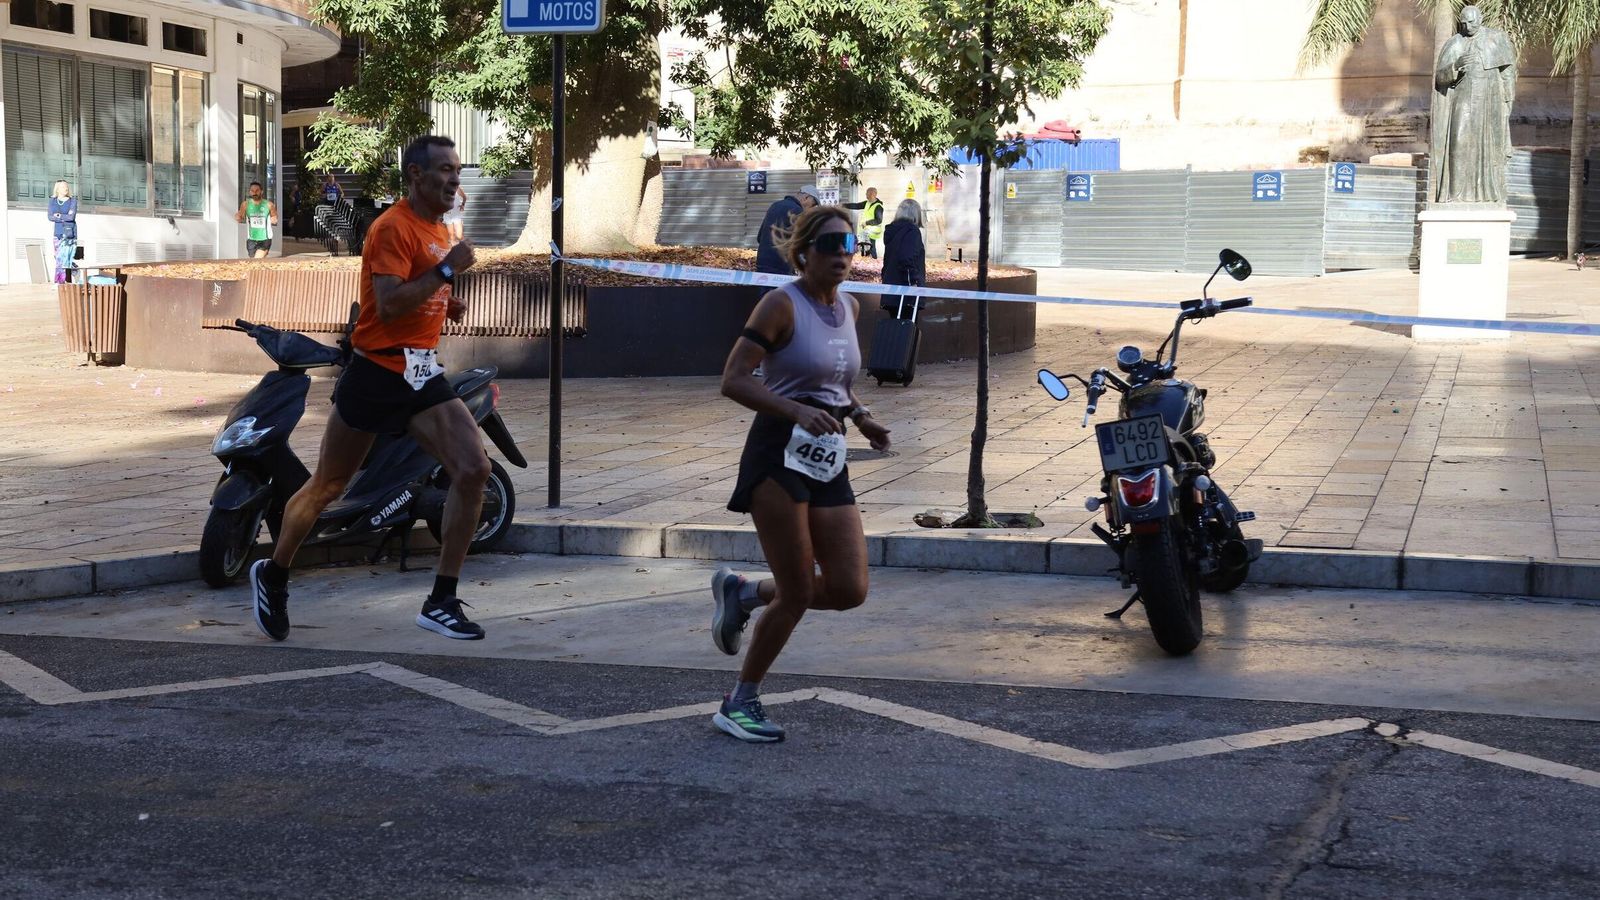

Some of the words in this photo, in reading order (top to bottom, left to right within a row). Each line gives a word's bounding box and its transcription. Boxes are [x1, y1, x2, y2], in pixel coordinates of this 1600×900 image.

[540, 1, 594, 20] MOTOS
[412, 364, 432, 378] 150
[1114, 421, 1161, 445] 6492
[795, 442, 837, 468] 464
[1123, 442, 1158, 464] LCD
[380, 490, 412, 518] YAMAHA
